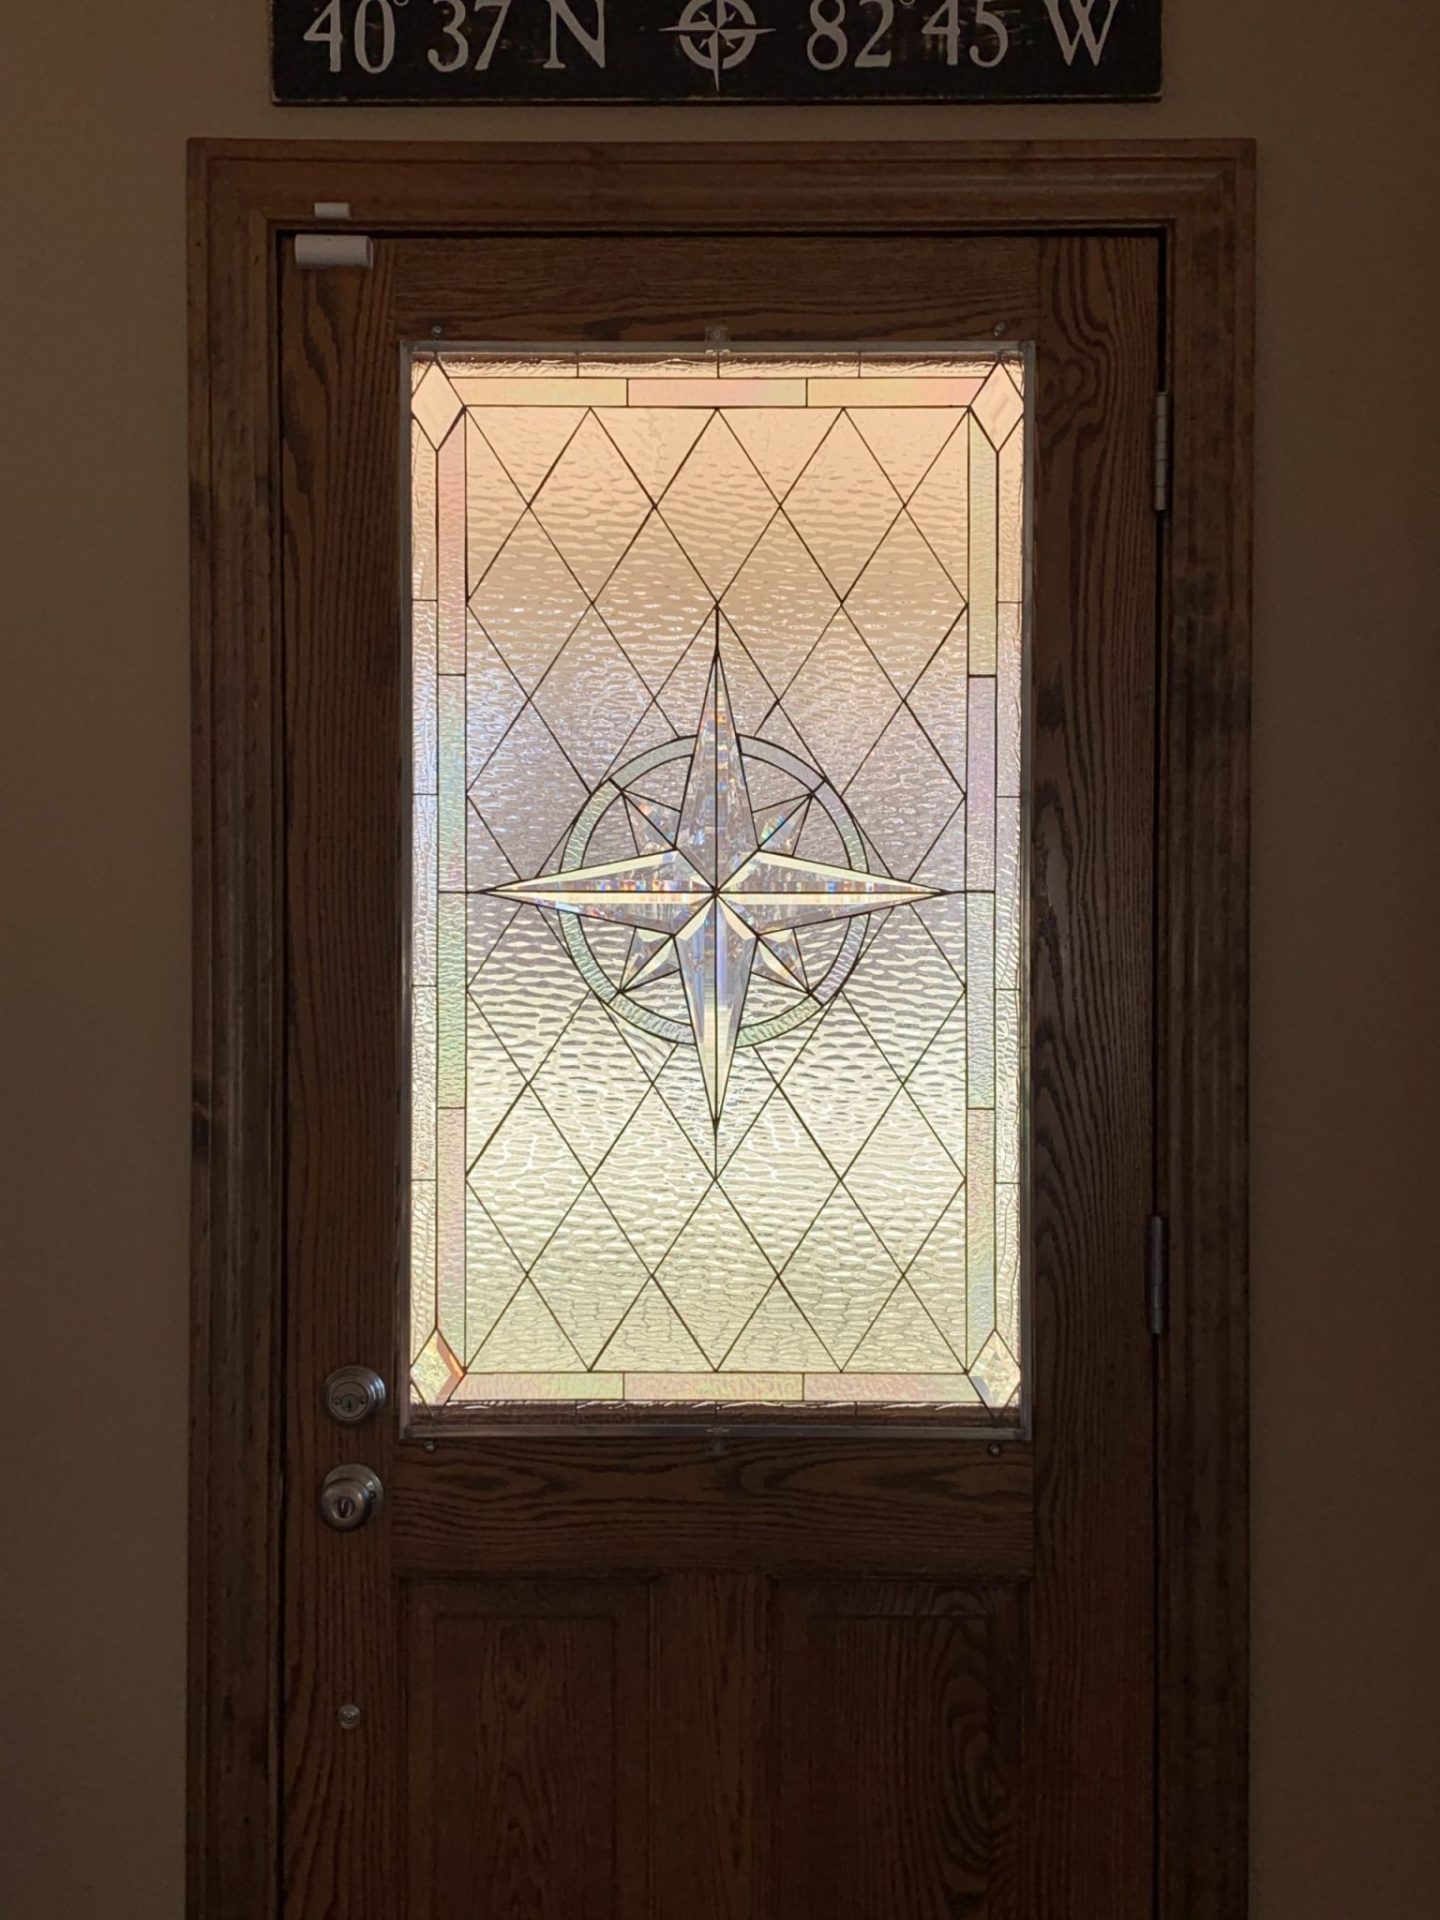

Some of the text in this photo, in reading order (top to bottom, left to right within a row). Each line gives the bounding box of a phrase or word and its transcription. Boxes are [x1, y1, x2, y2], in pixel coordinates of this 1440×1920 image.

[427, 0, 511, 72] 37
[543, 0, 606, 69] N
[921, 0, 1009, 67] 45
[1042, 0, 1119, 66] W
